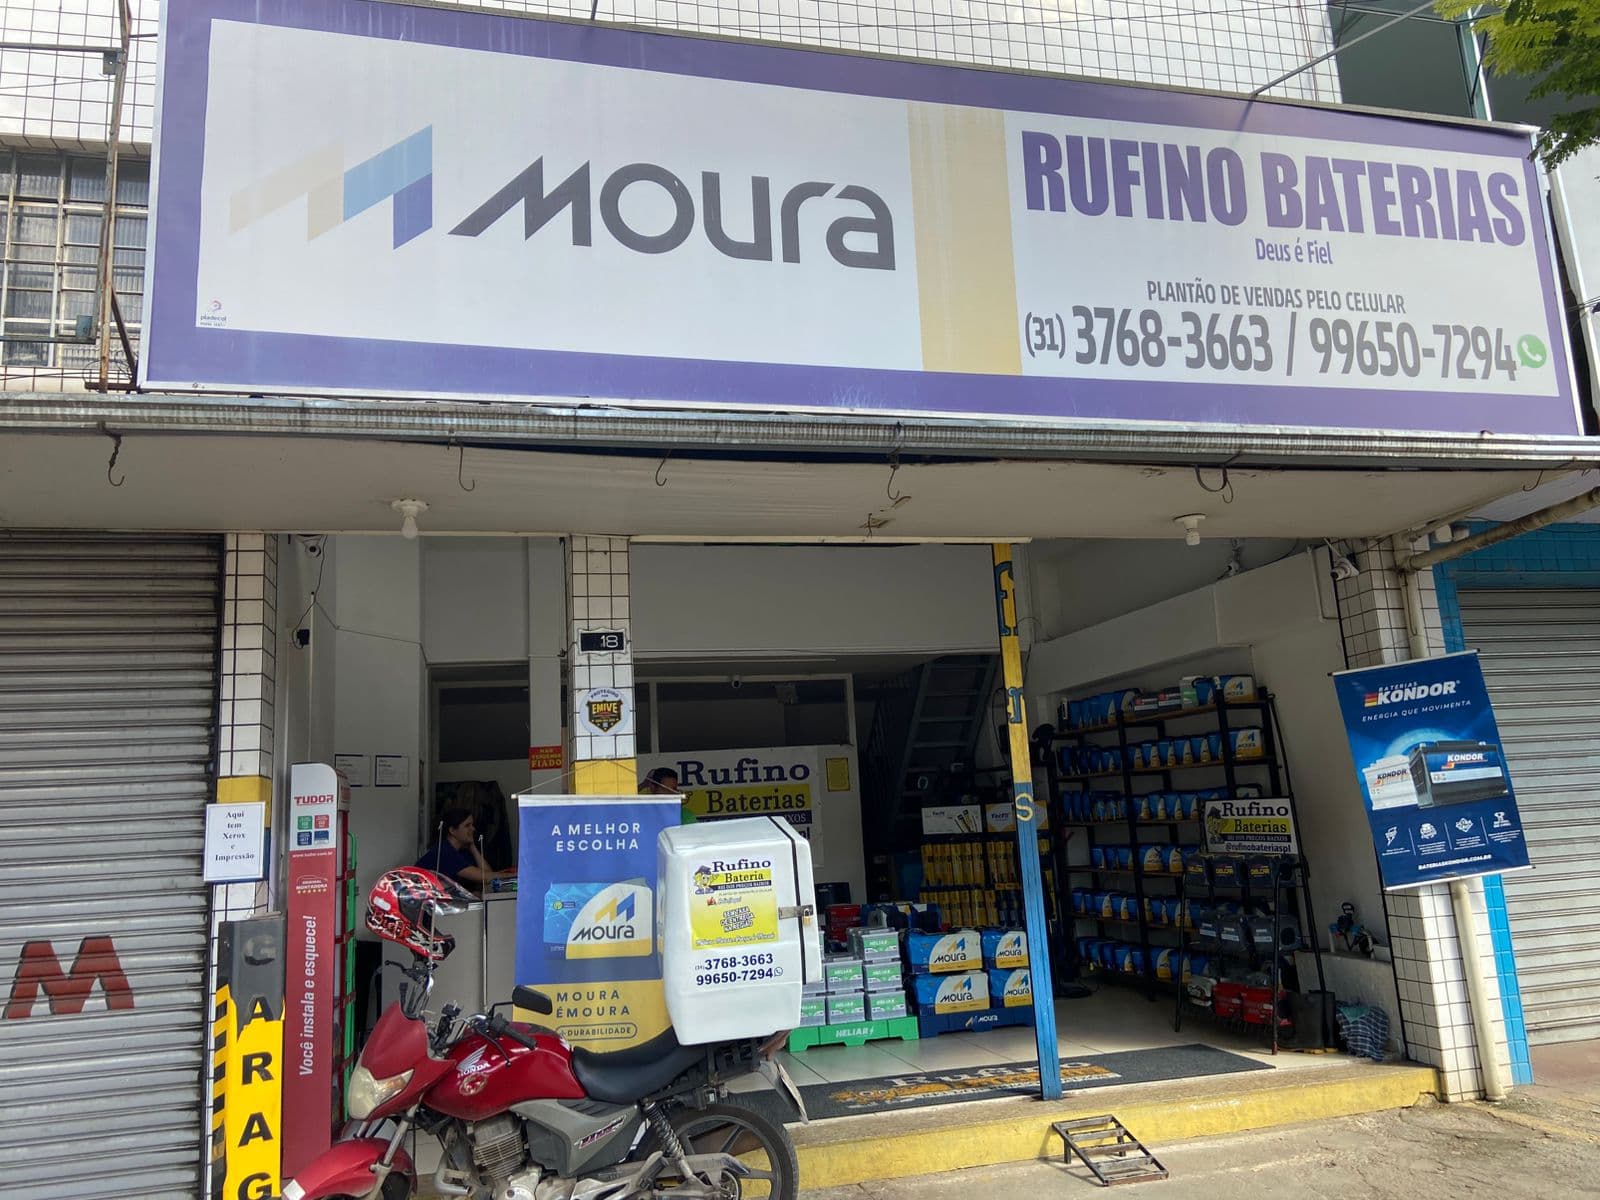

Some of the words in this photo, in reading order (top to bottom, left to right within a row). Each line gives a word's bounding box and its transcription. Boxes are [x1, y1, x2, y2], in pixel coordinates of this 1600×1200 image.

[1021, 130, 1248, 227] RUFINO
[1259, 151, 1526, 247] BATERIAS
[1255, 237, 1290, 262] Deus
[1295, 237, 1303, 263] é
[1307, 239, 1334, 265] Fiel
[1147, 276, 1216, 305] PLANTÃO
[1220, 285, 1241, 306] DE
[1242, 286, 1303, 309] VENDAS
[1306, 289, 1341, 311] PELO
[1346, 291, 1406, 314] CELULAR
[1024, 311, 1066, 359] (31)
[1071, 305, 1273, 372] 3768-3663
[1309, 317, 1518, 381] 99650-7294
[599, 634, 619, 648] 18
[1376, 681, 1456, 706] KONDOR
[592, 702, 618, 715] EMIVE
[1362, 711, 1398, 723] ENERGIA
[1401, 707, 1418, 718] QUE
[1421, 700, 1471, 713] MOVIMENTA
[531, 759, 562, 768] FIADO
[1447, 752, 1483, 762] KONDOR
[677, 758, 810, 787] Rufino
[294, 794, 334, 804] TUDOR
[706, 788, 805, 814] Baterias
[226, 812, 244, 820] Aqui
[1221, 802, 1289, 817] Rufino
[551, 825, 561, 836] A
[568, 822, 641, 835] MELHOR
[1234, 819, 1287, 833] Baterias
[222, 832, 246, 840] Xerox
[556, 839, 639, 852] ESCOLHA
[215, 853, 255, 863] Impressão
[712, 859, 771, 873] Rufino
[725, 871, 764, 883] Bateria
[302, 916, 319, 977] esquece!
[704, 953, 774, 970] 3768-3663
[305, 980, 314, 988] e
[696, 968, 774, 986] 99650-7294
[556, 990, 620, 1002] MOURA
[300, 992, 315, 1038] instala
[836, 1027, 869, 1038] HELIAR
[300, 1041, 314, 1077] Você
